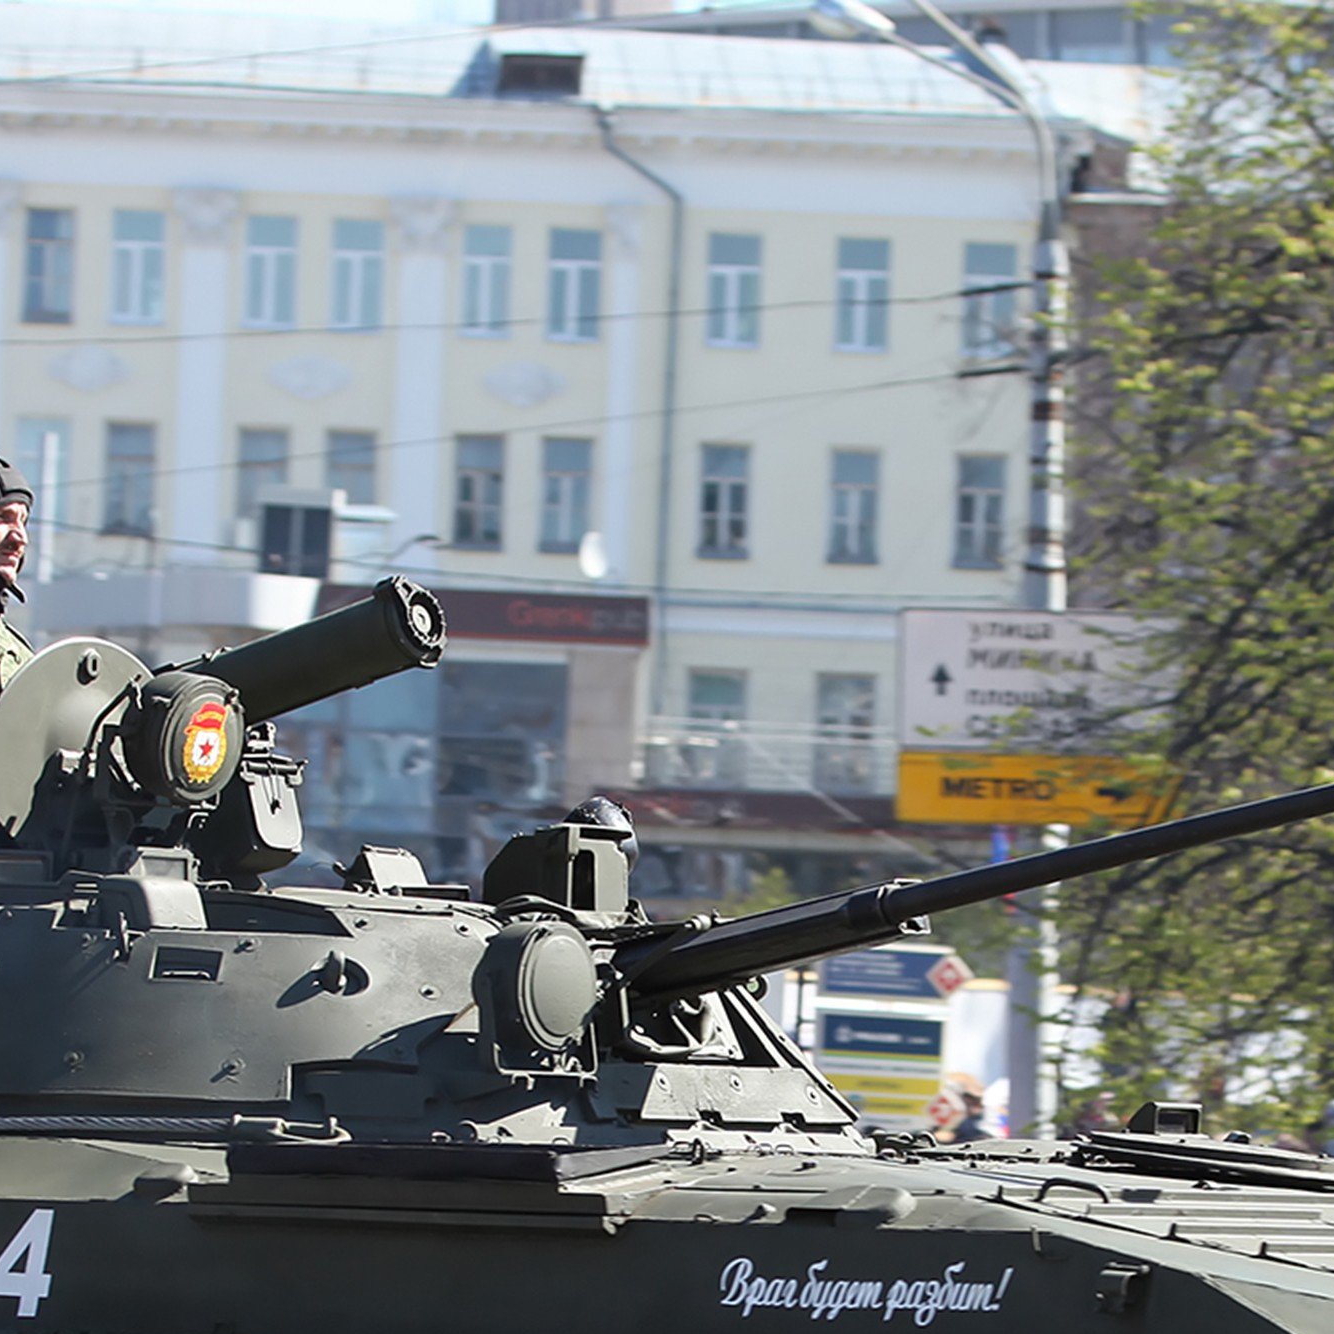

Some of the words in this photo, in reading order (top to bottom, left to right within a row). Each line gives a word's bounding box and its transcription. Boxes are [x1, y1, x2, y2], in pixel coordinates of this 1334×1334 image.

[968, 621, 1054, 643] улица
[720, 1257, 798, 1318] Враг
[799, 1258, 884, 1321] будет
[881, 1260, 1014, 1327] разбит!
